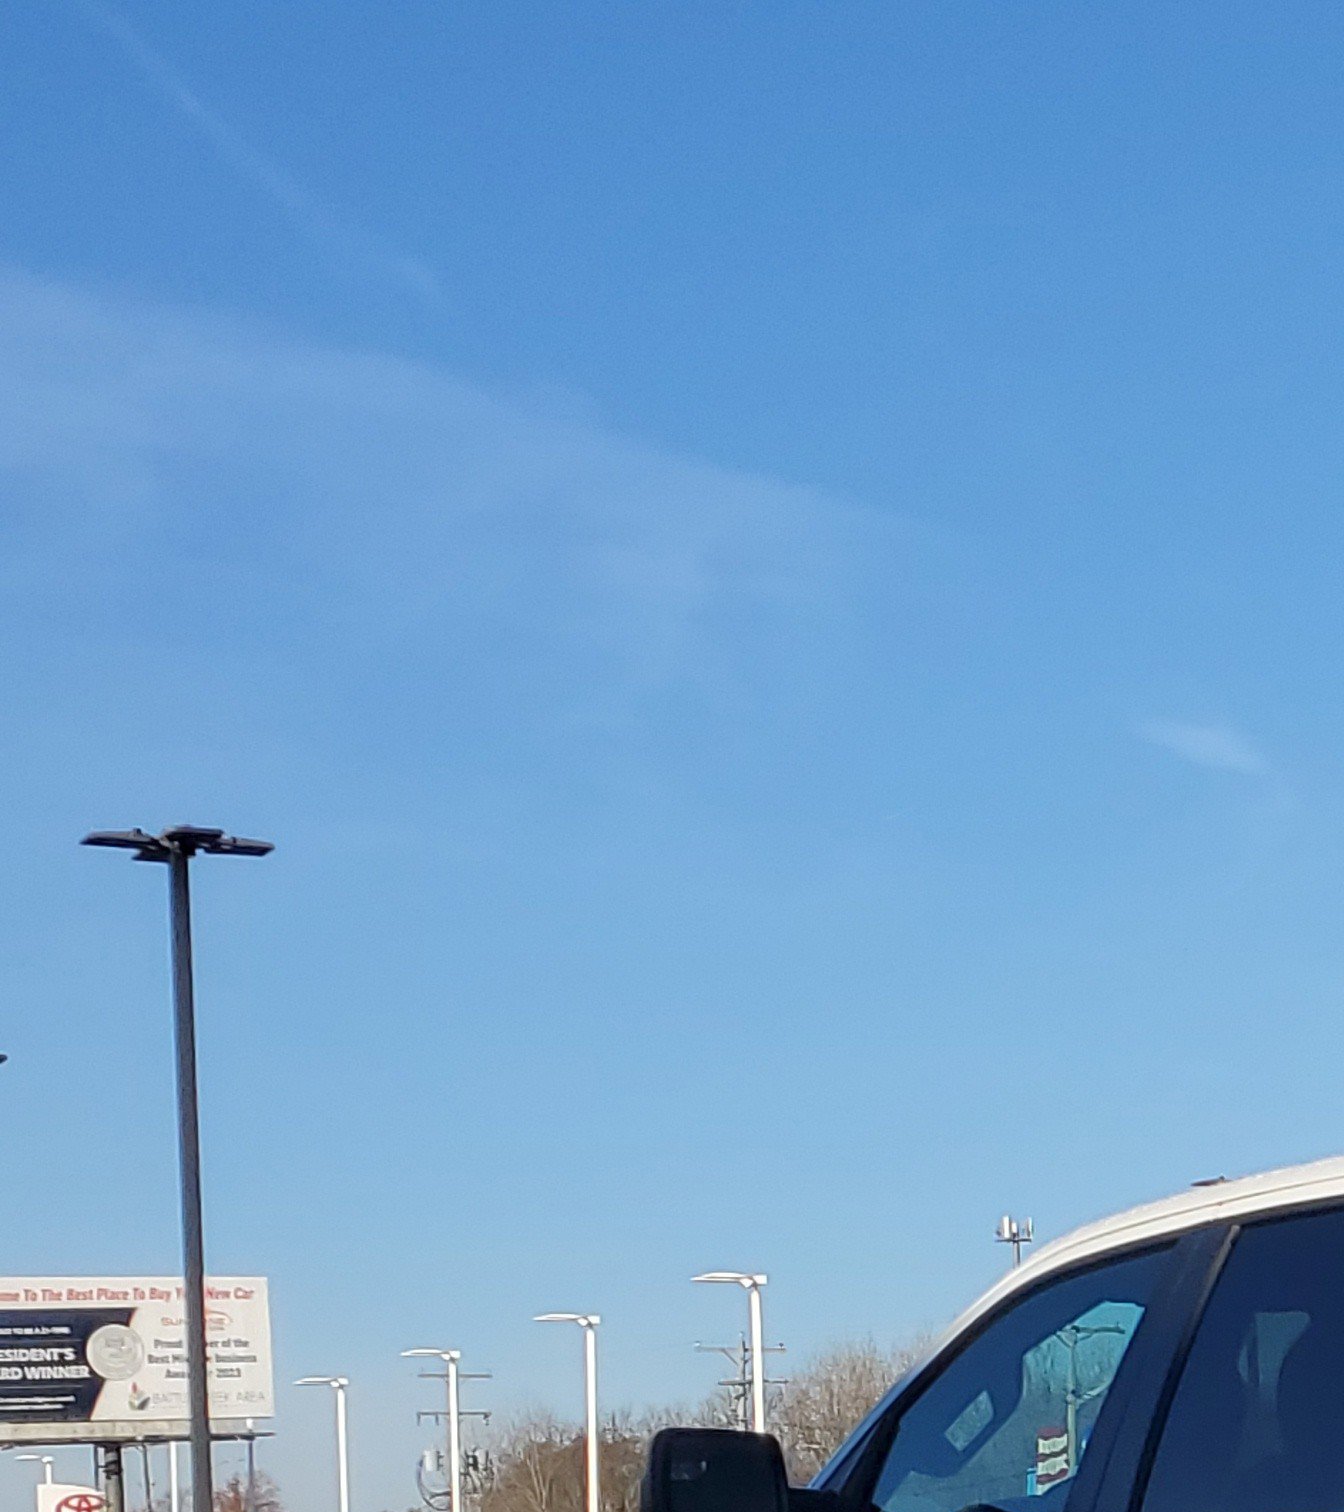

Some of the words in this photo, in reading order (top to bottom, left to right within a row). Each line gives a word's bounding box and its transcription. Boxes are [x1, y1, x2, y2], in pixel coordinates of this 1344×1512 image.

[24, 1289, 37, 1301] To
[42, 1288, 63, 1301] The
[67, 1288, 94, 1301] Best
[97, 1288, 129, 1301] Place
[133, 1287, 146, 1300] To
[150, 1287, 171, 1303] Buy
[234, 1287, 254, 1299] Car
[24, 1365, 91, 1379] WINNER
